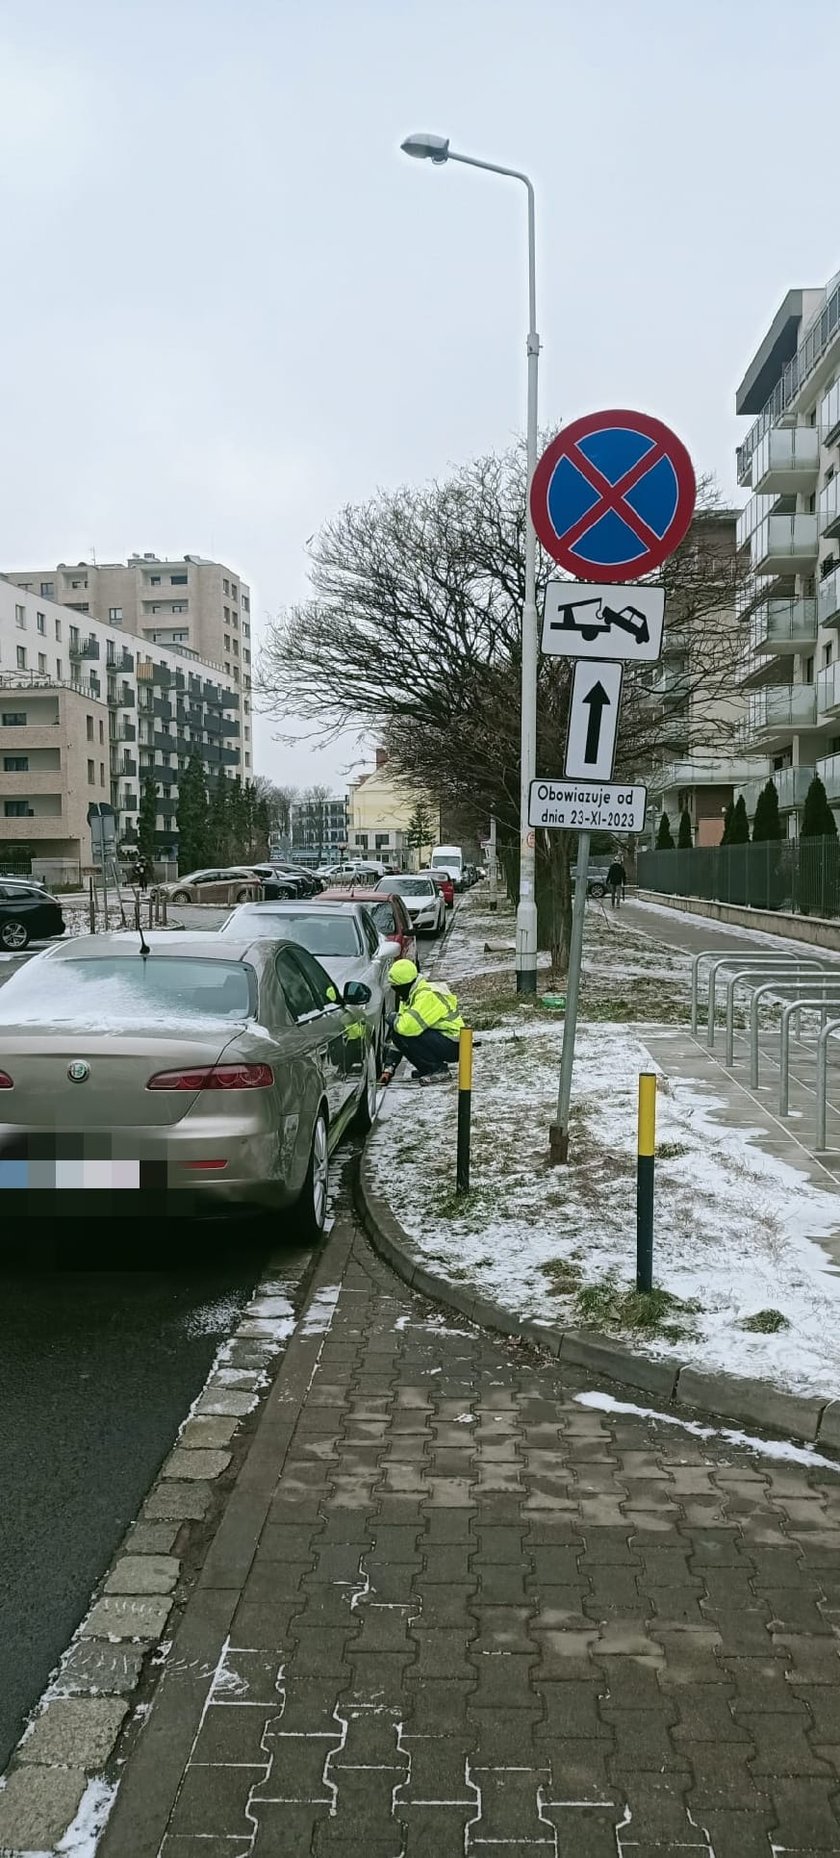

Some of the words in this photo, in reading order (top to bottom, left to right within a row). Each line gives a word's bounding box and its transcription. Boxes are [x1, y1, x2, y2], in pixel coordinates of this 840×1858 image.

[618, 790, 634, 805] od
[541, 809, 565, 824] dnia
[570, 810, 635, 827] 23-XI-2023
